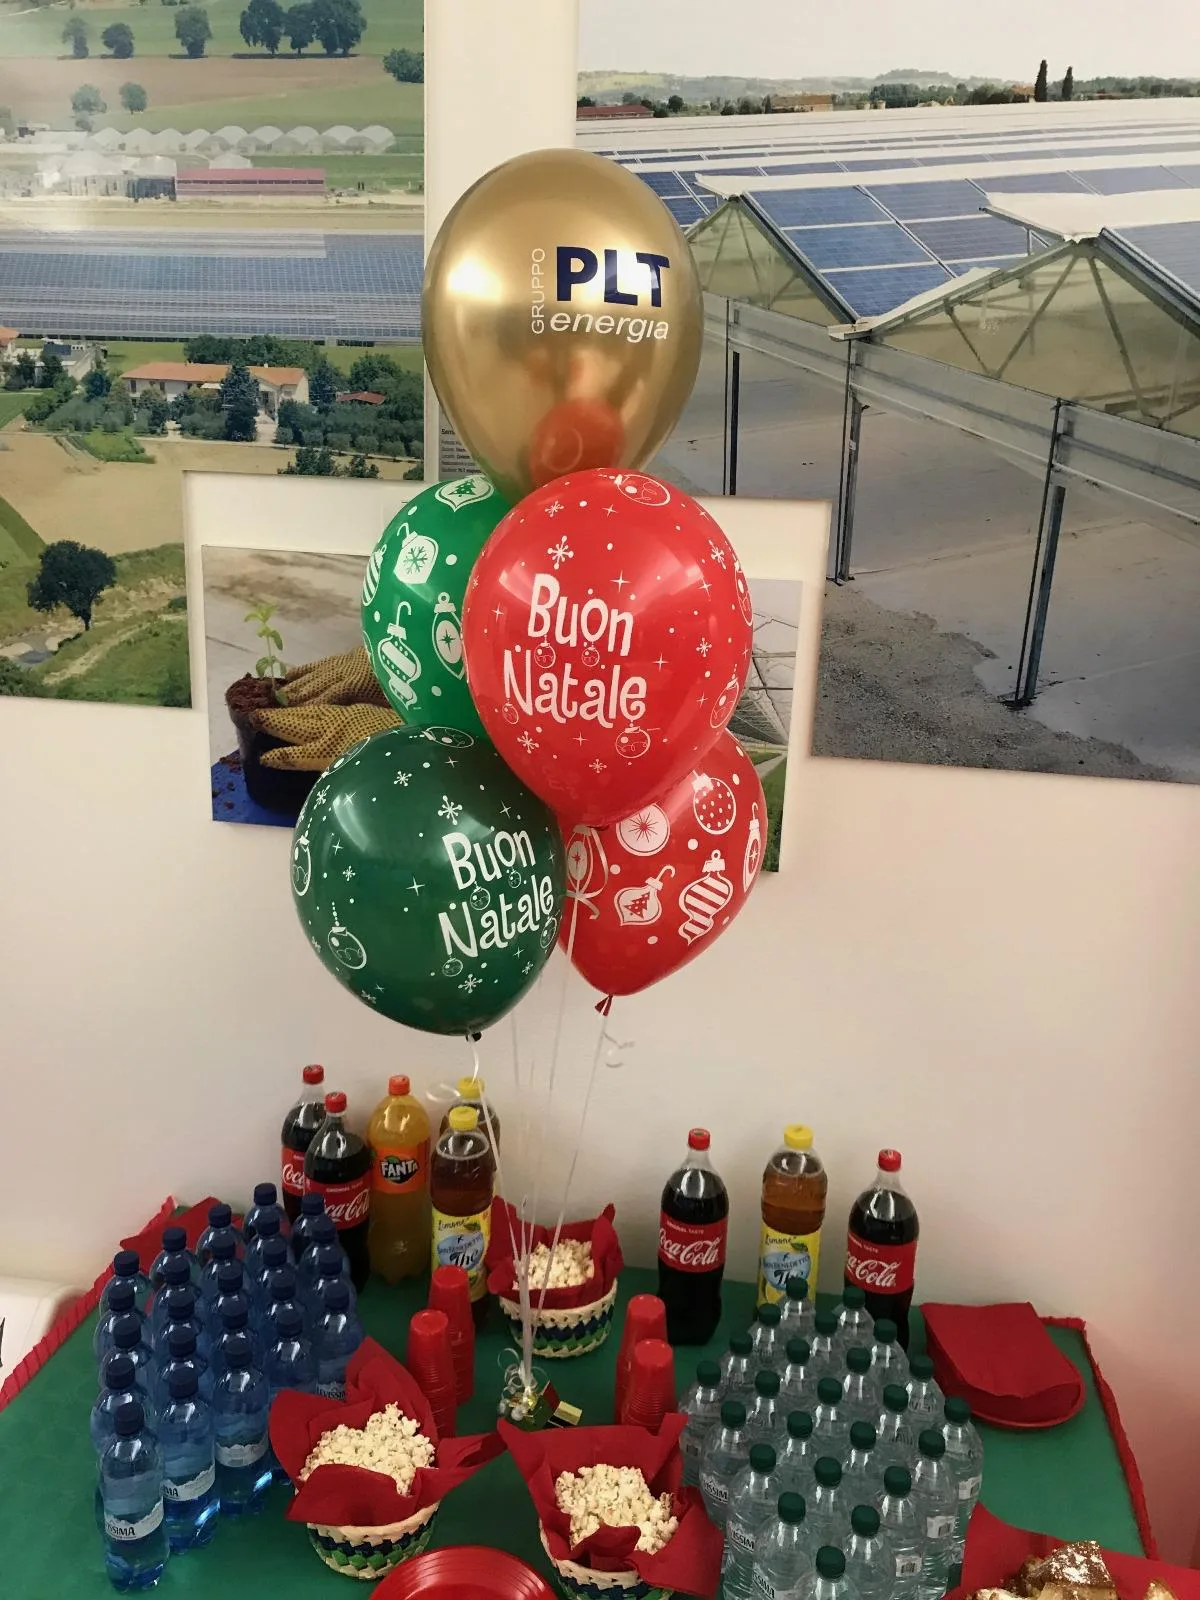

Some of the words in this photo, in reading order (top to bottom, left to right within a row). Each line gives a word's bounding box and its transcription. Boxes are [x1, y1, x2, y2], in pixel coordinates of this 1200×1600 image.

[531, 248, 546, 335] GRUPPO
[556, 246, 670, 308] PLT
[550, 311, 669, 343] energia
[527, 573, 634, 656] Buon
[503, 649, 647, 729] Natale
[441, 830, 536, 890] Buon
[438, 874, 554, 958] Natale
